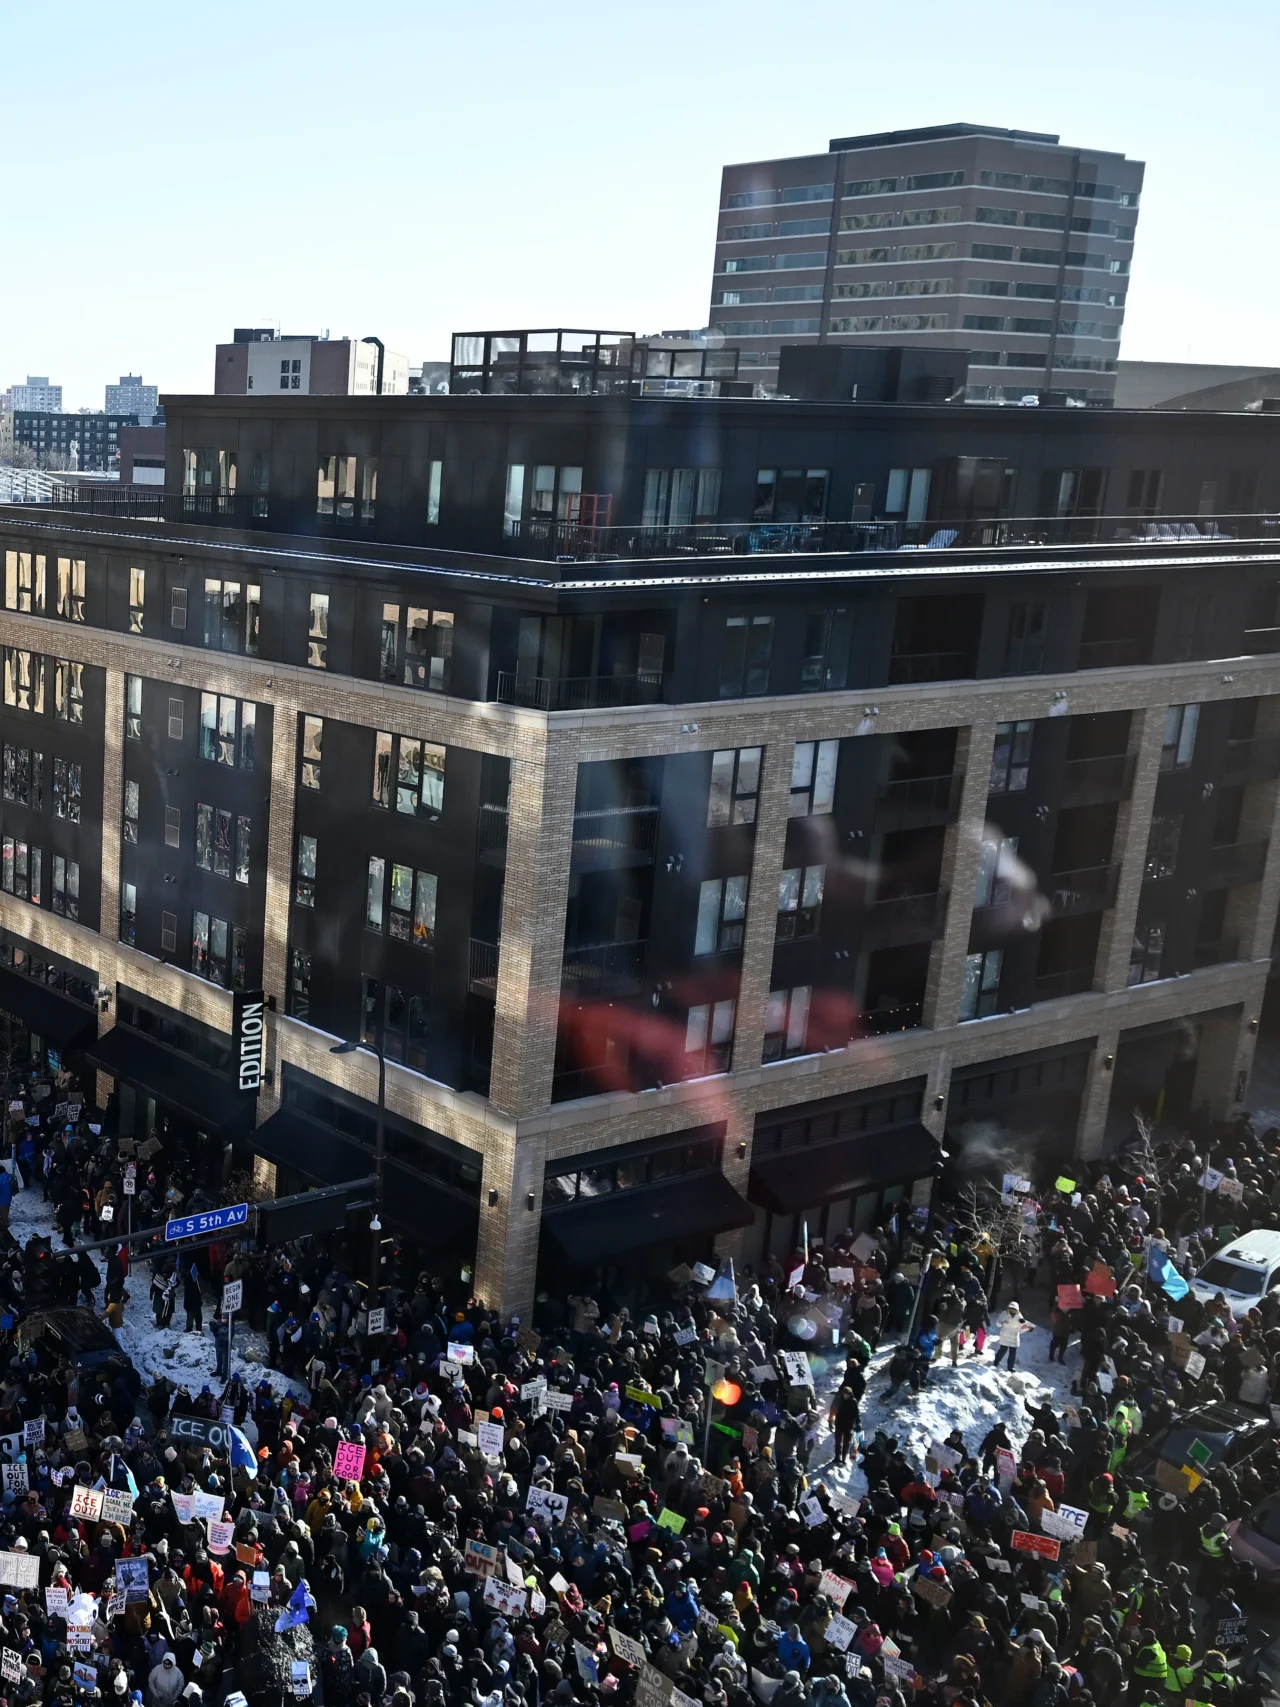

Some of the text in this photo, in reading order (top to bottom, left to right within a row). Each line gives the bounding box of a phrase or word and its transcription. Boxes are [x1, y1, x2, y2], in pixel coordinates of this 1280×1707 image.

[239, 1001, 264, 1090] EDITION
[186, 1209, 245, 1232] S 5th Av
[225, 1284, 241, 1294] BEGIN
[226, 1293, 240, 1303] ONE
[224, 1302, 240, 1310] WAY
[371, 1317, 382, 1325] WAY
[171, 1418, 231, 1449] ICE OU
[339, 1442, 364, 1456] ICE
[337, 1452, 363, 1465] OUT
[7, 1464, 25, 1472] ICE
[336, 1462, 359, 1473] FOR
[6, 1472, 26, 1480] OUT
[334, 1470, 359, 1480] GOOD
[8, 1479, 27, 1488] FOR
[106, 1488, 120, 1498] ICE
[75, 1494, 97, 1508] ICE
[106, 1498, 122, 1507] SCARE
[530, 1495, 543, 1503] OUT
[73, 1504, 97, 1518] OUT!
[1060, 1507, 1087, 1528] ICE
[2, 1556, 37, 1574] FUCK
[465, 1553, 494, 1573] OUT
[6, 1571, 35, 1583] ICE
[825, 1572, 846, 1590] HATE
[503, 1583, 522, 1595] SECRET
[1224, 1627, 1239, 1635] ICE
[619, 1635, 633, 1649] BE
[4, 1650, 19, 1661] SAY
[724, 1655, 736, 1667] ICE
[847, 1654, 861, 1664] ICE
[642, 1664, 662, 1686] NO
[847, 1665, 860, 1676] OUT
